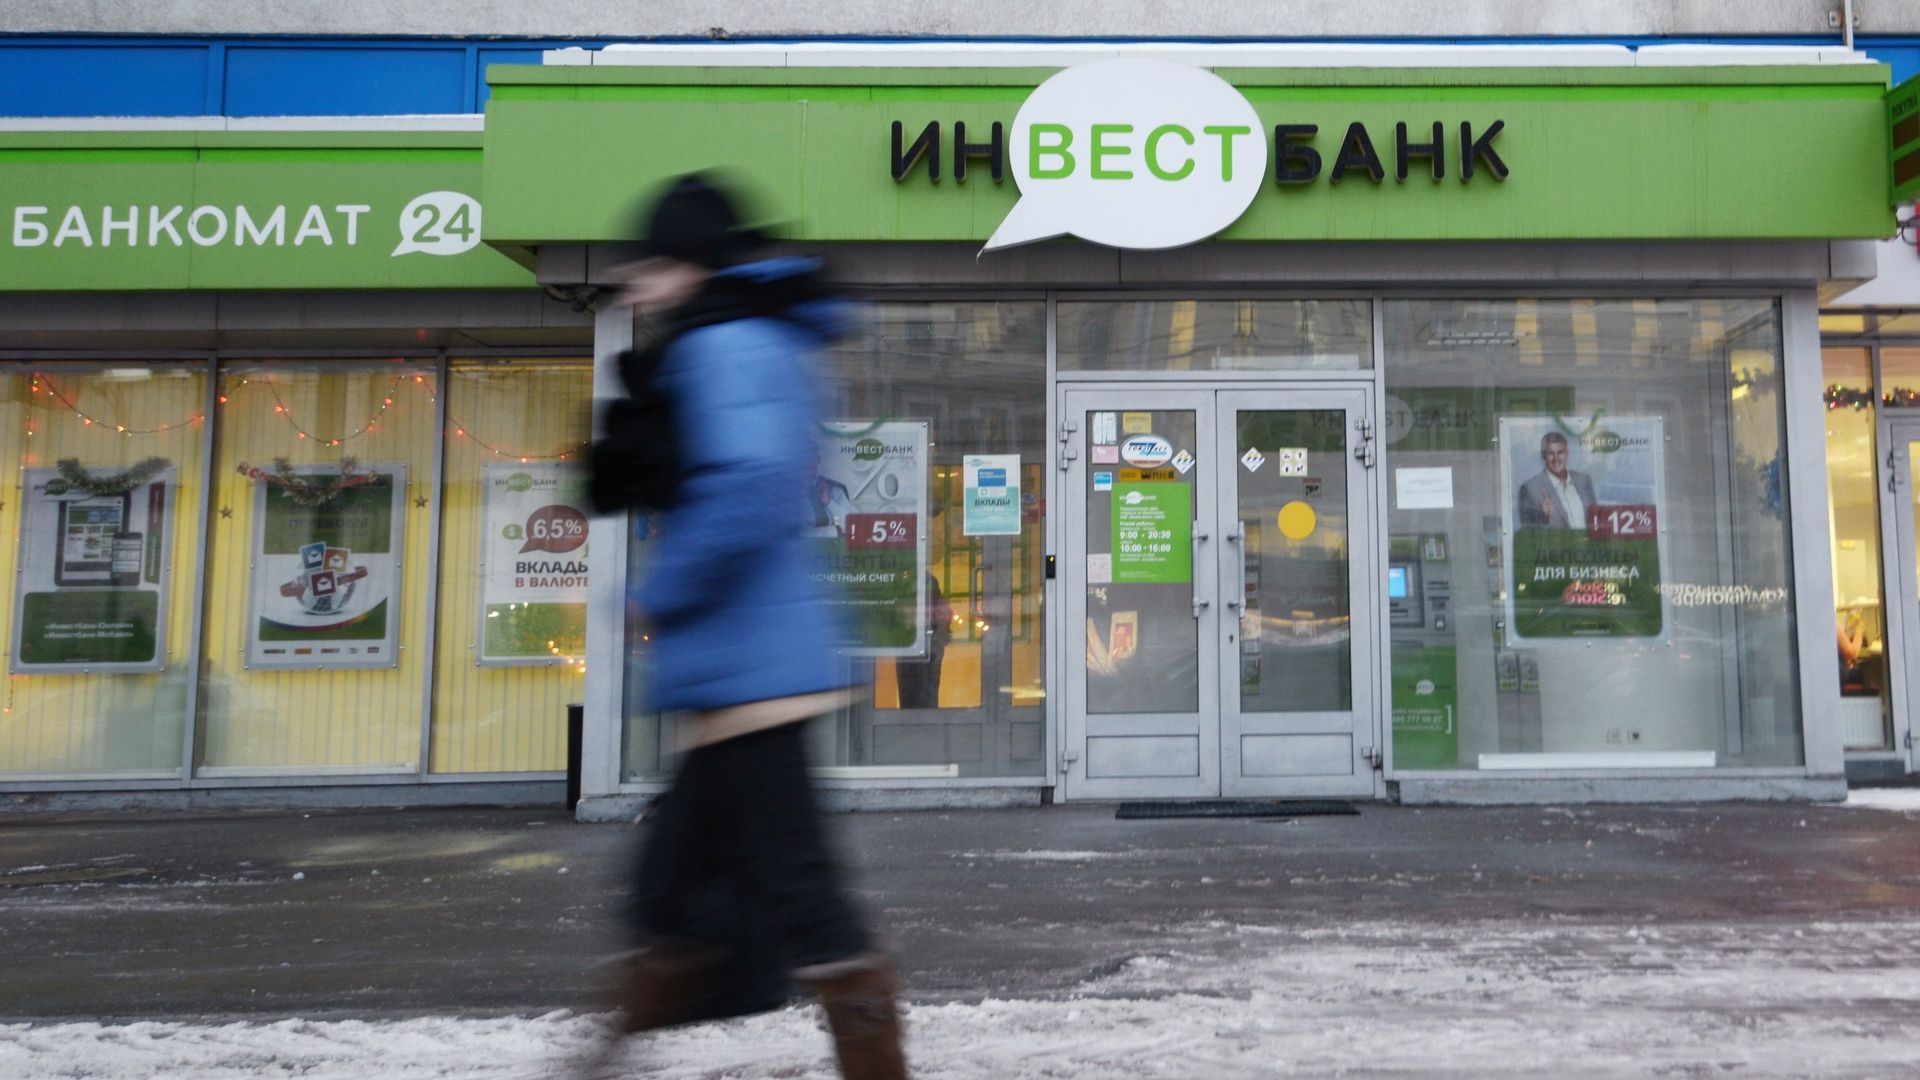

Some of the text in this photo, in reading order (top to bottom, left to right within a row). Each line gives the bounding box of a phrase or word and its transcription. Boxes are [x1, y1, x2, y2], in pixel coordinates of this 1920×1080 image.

[890, 119, 1510, 183] ИНВЕСТБАНК
[13, 203, 474, 247] БАНКОМАТ 24
[840, 444, 913, 454] ИНВЕСТБАНК
[1579, 437, 1649, 447] ИНВЕСТБАНК
[974, 498, 1011, 507] ВКЛАДЫ
[533, 518, 582, 541] 6,5%
[1607, 510, 1652, 535] 12%
[871, 520, 906, 543] 5%
[1120, 530, 1138, 539] 9:00
[1147, 530, 1171, 539] 20:30
[810, 572, 897, 583] АСЧЕТНЫЙ СЧЕТ
[1534, 564, 1641, 581] ДЛЯ БИЗНЕСА
[515, 577, 524, 588] В
